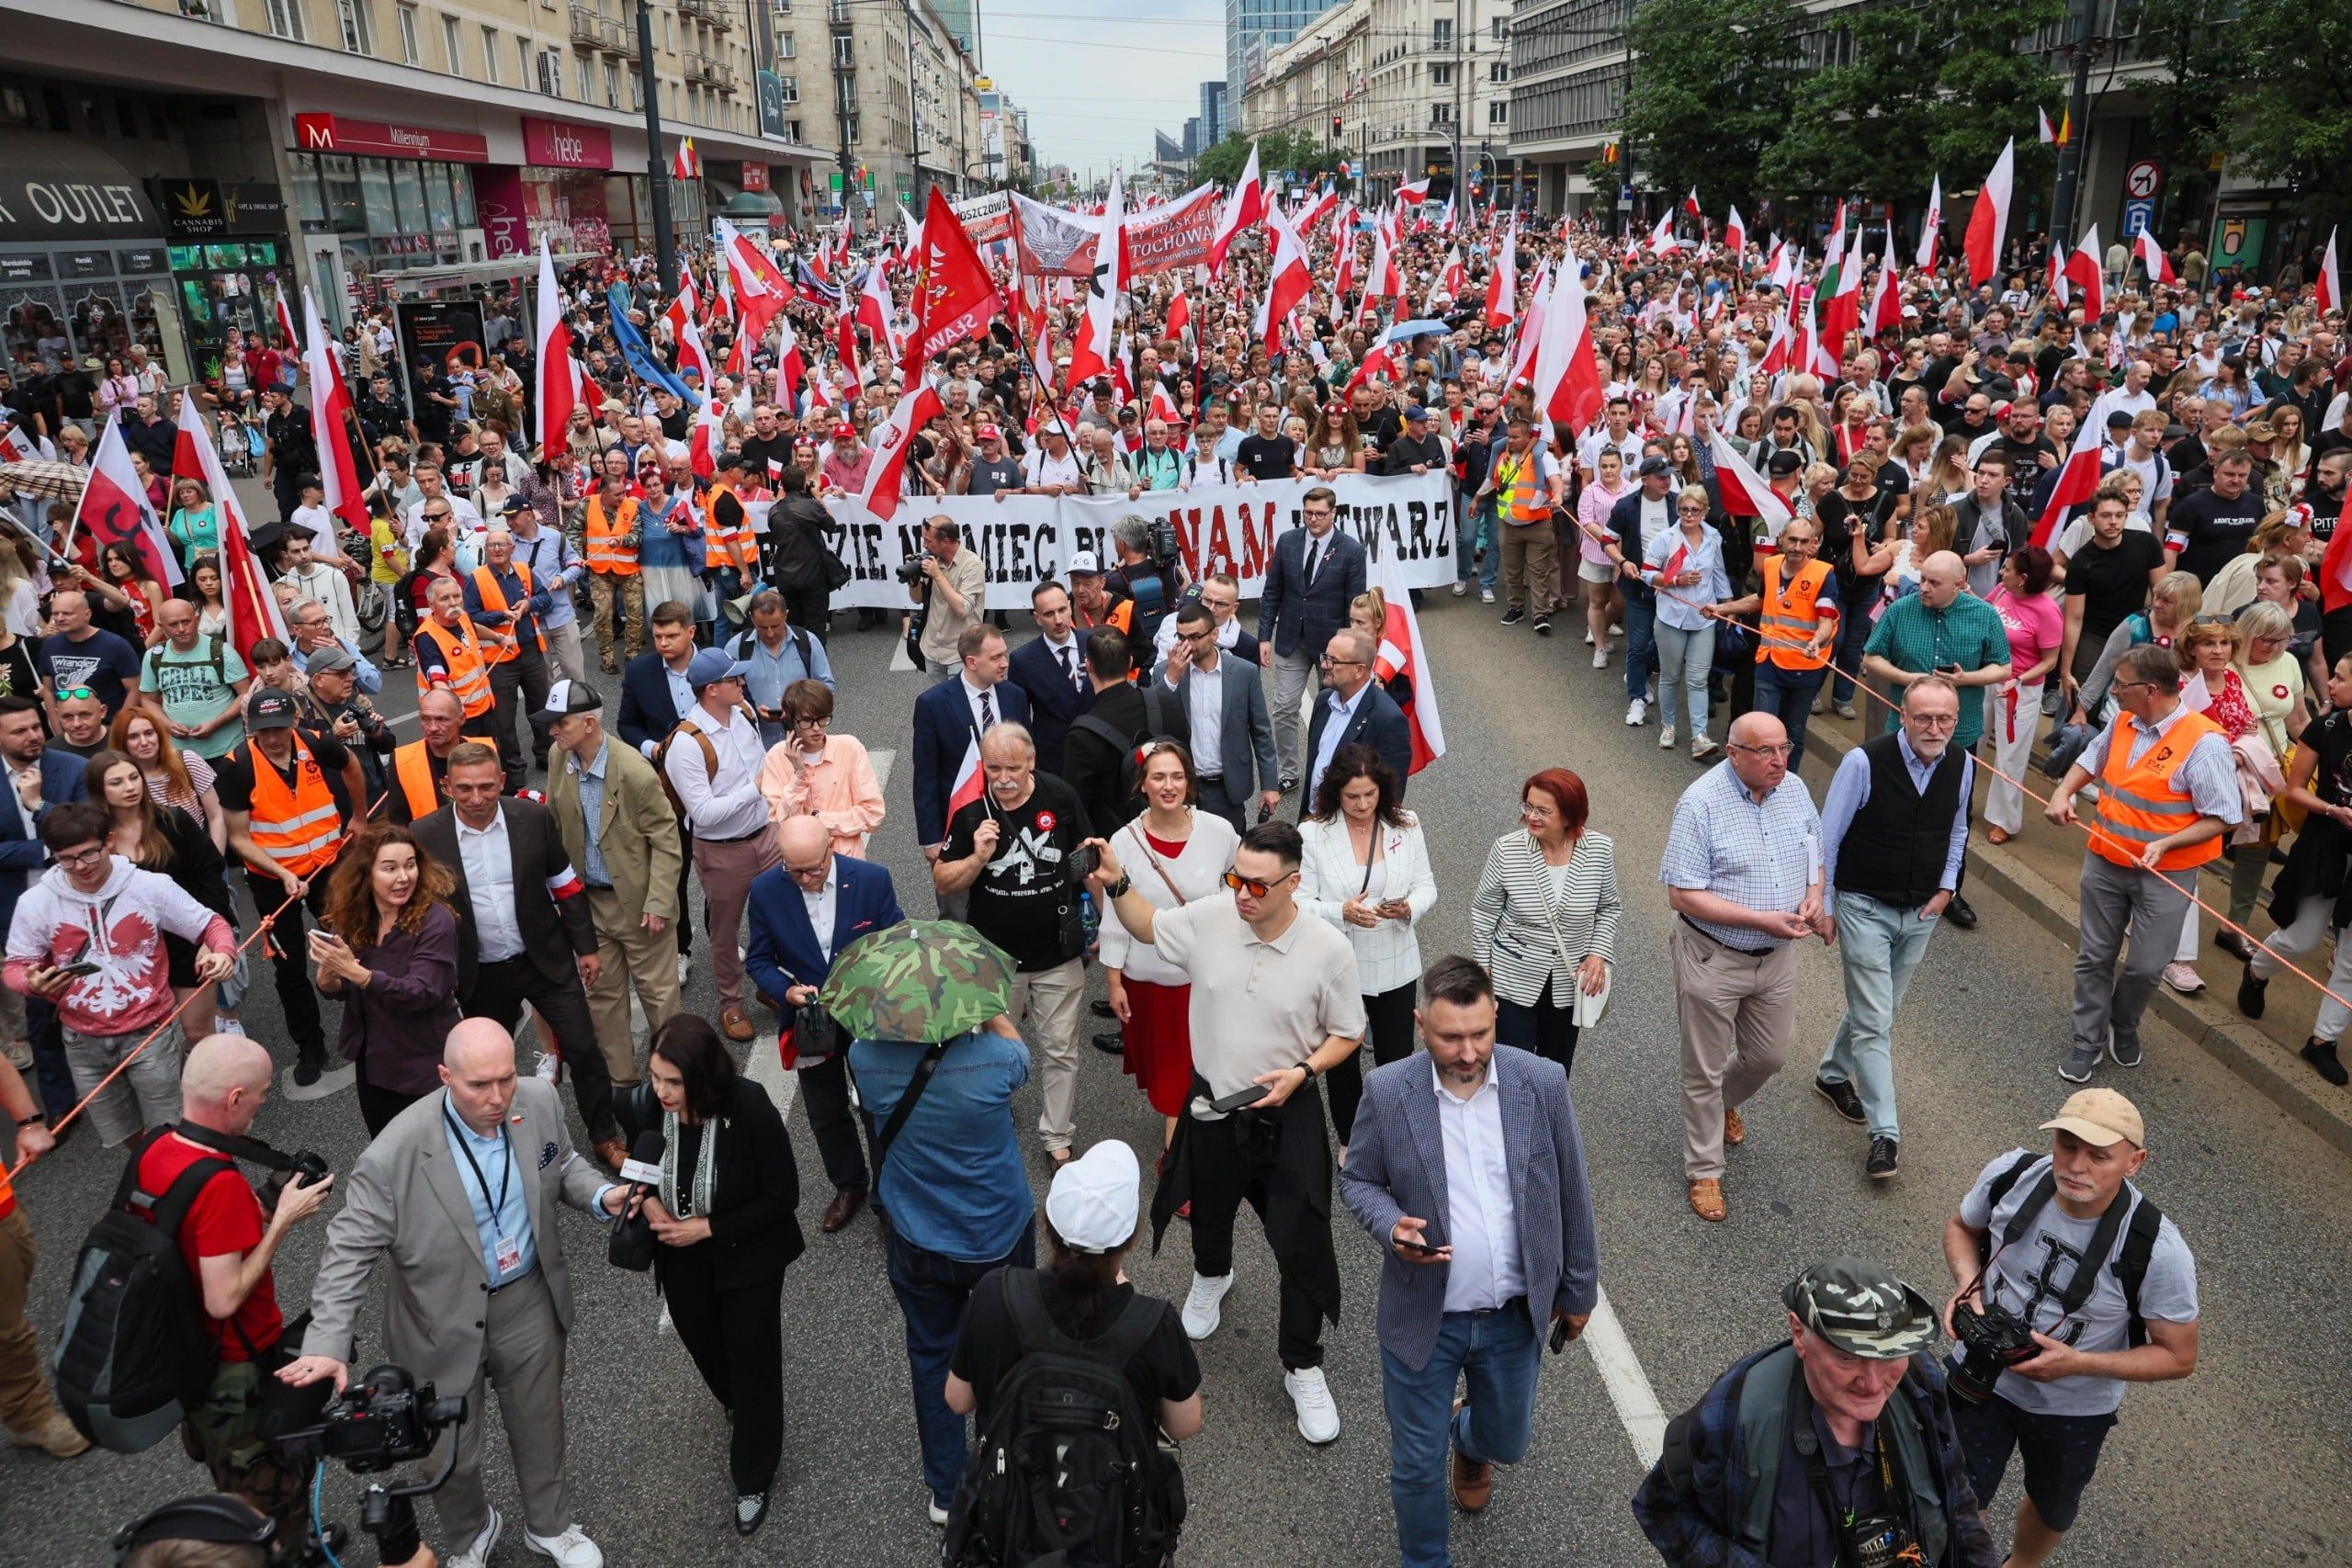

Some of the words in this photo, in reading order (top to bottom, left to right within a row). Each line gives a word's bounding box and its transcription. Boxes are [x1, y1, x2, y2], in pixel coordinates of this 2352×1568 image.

[306, 124, 334, 149] M
[389, 124, 431, 147] Millennium
[553, 125, 582, 163] hebe
[26, 182, 143, 224] OUTLET
[174, 218, 223, 227] CANNABIS
[492, 216, 518, 254] he
[1086, 225, 1214, 259] CTOCHOWA
[1170, 501, 1276, 583] NAM
[55, 659, 96, 671] Wrangler
